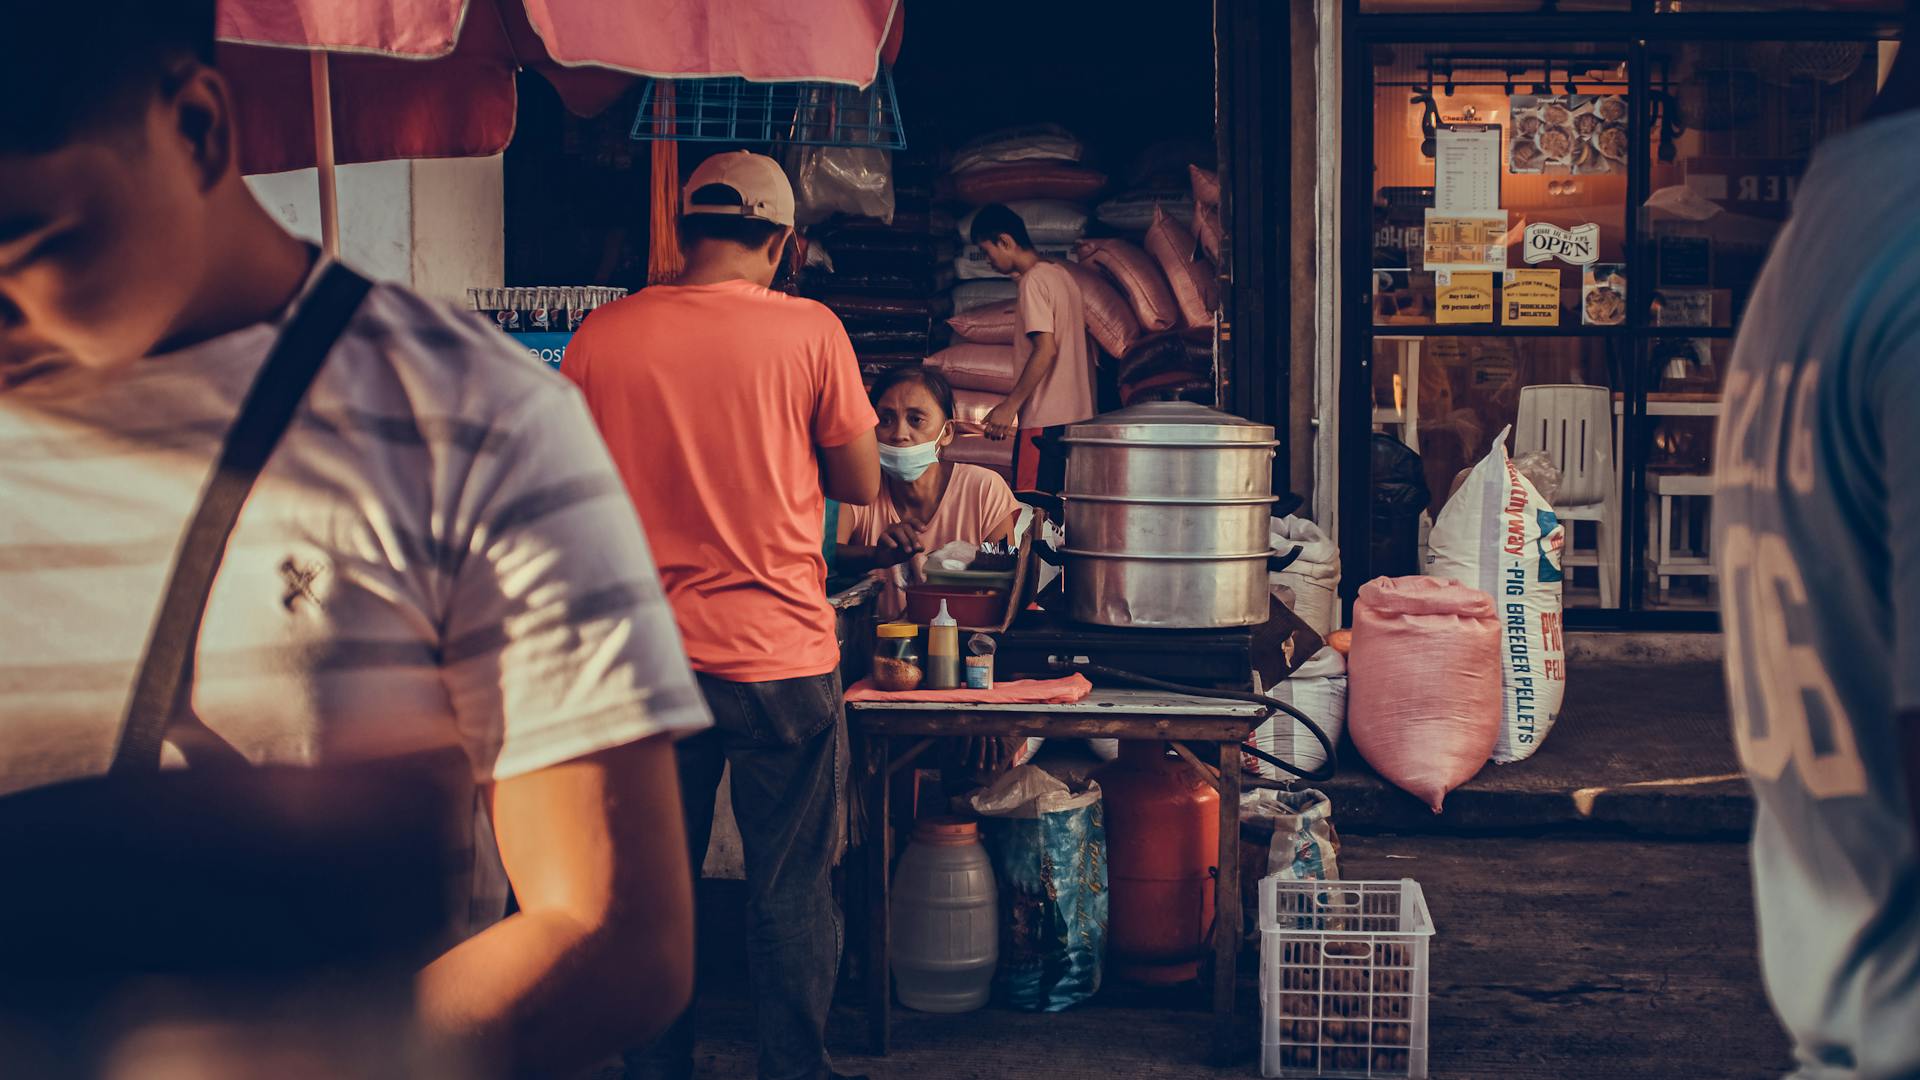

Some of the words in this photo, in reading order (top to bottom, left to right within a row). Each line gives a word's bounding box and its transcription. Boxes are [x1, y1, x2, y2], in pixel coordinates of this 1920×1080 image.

[1532, 234, 1590, 257] OPEN
[1506, 603, 1531, 672] BREEDER
[1514, 677, 1535, 744] PELLETS
